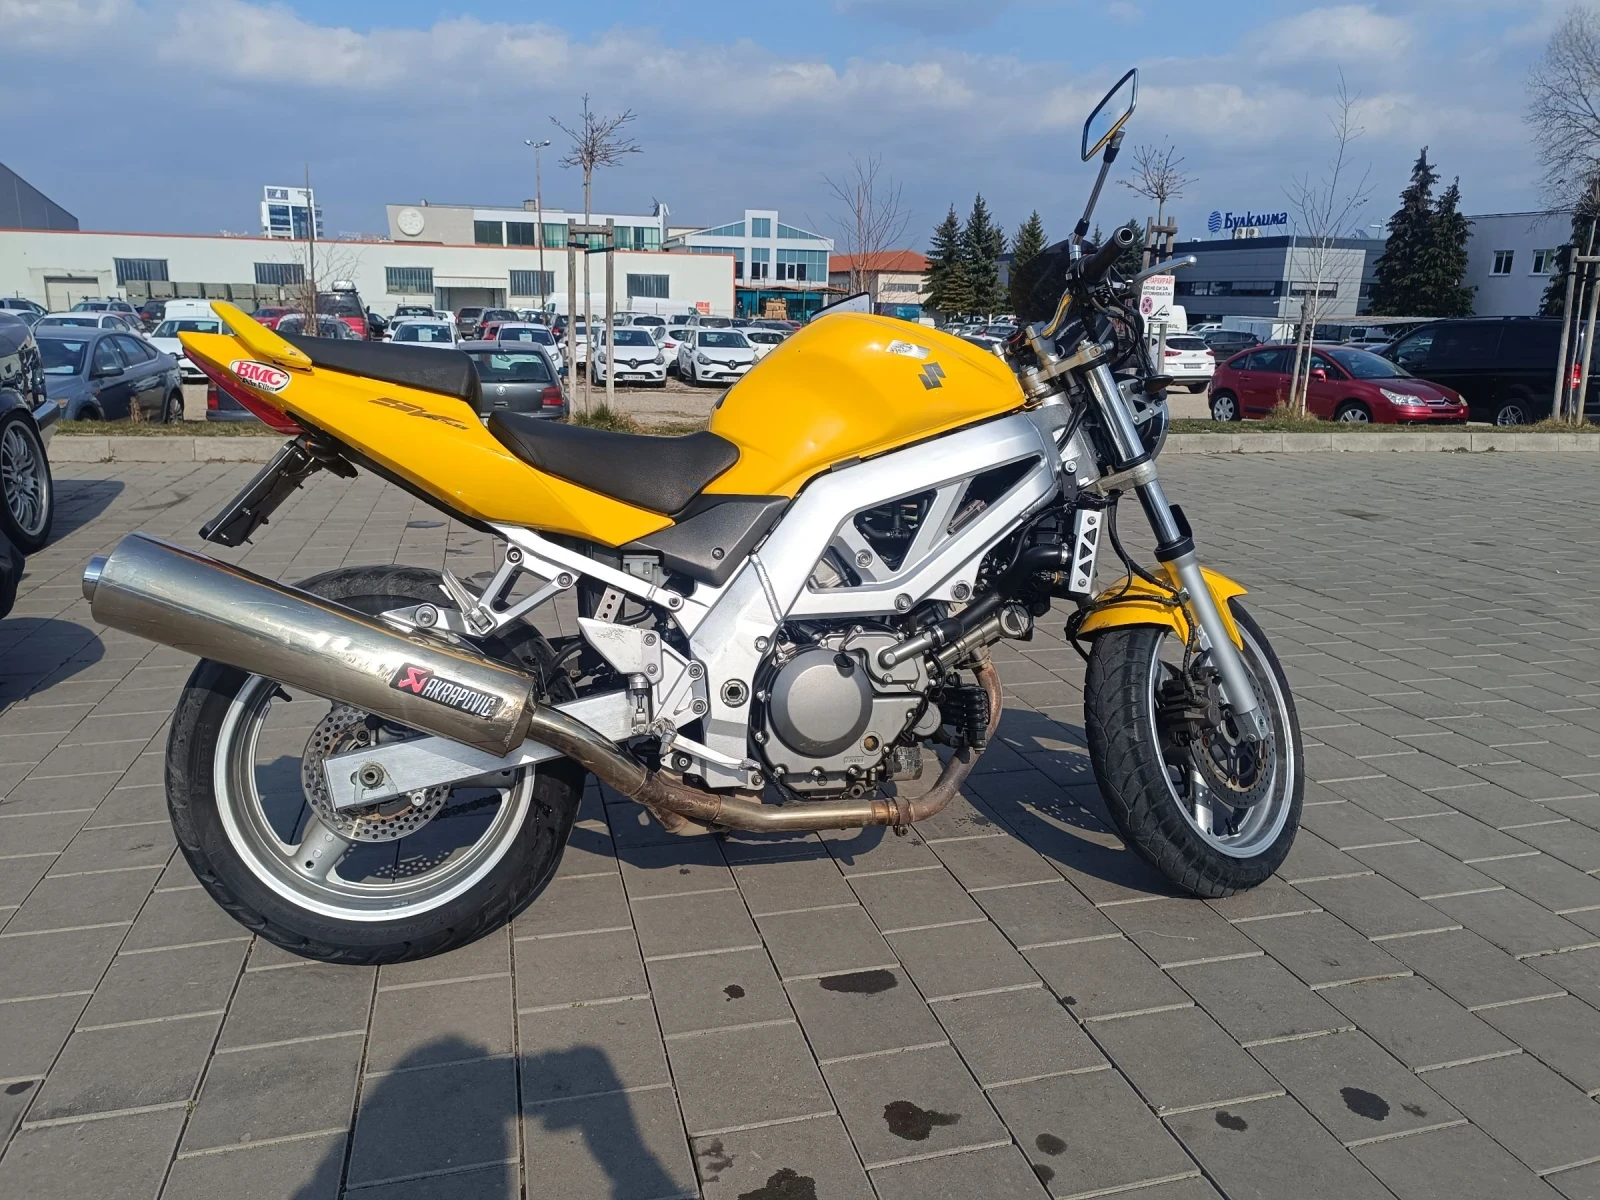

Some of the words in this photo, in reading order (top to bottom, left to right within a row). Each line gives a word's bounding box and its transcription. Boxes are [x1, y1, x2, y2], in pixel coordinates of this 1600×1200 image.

[1224, 211, 1288, 233] Булклима
[236, 361, 281, 385] BMC
[257, 382, 275, 392] Filter
